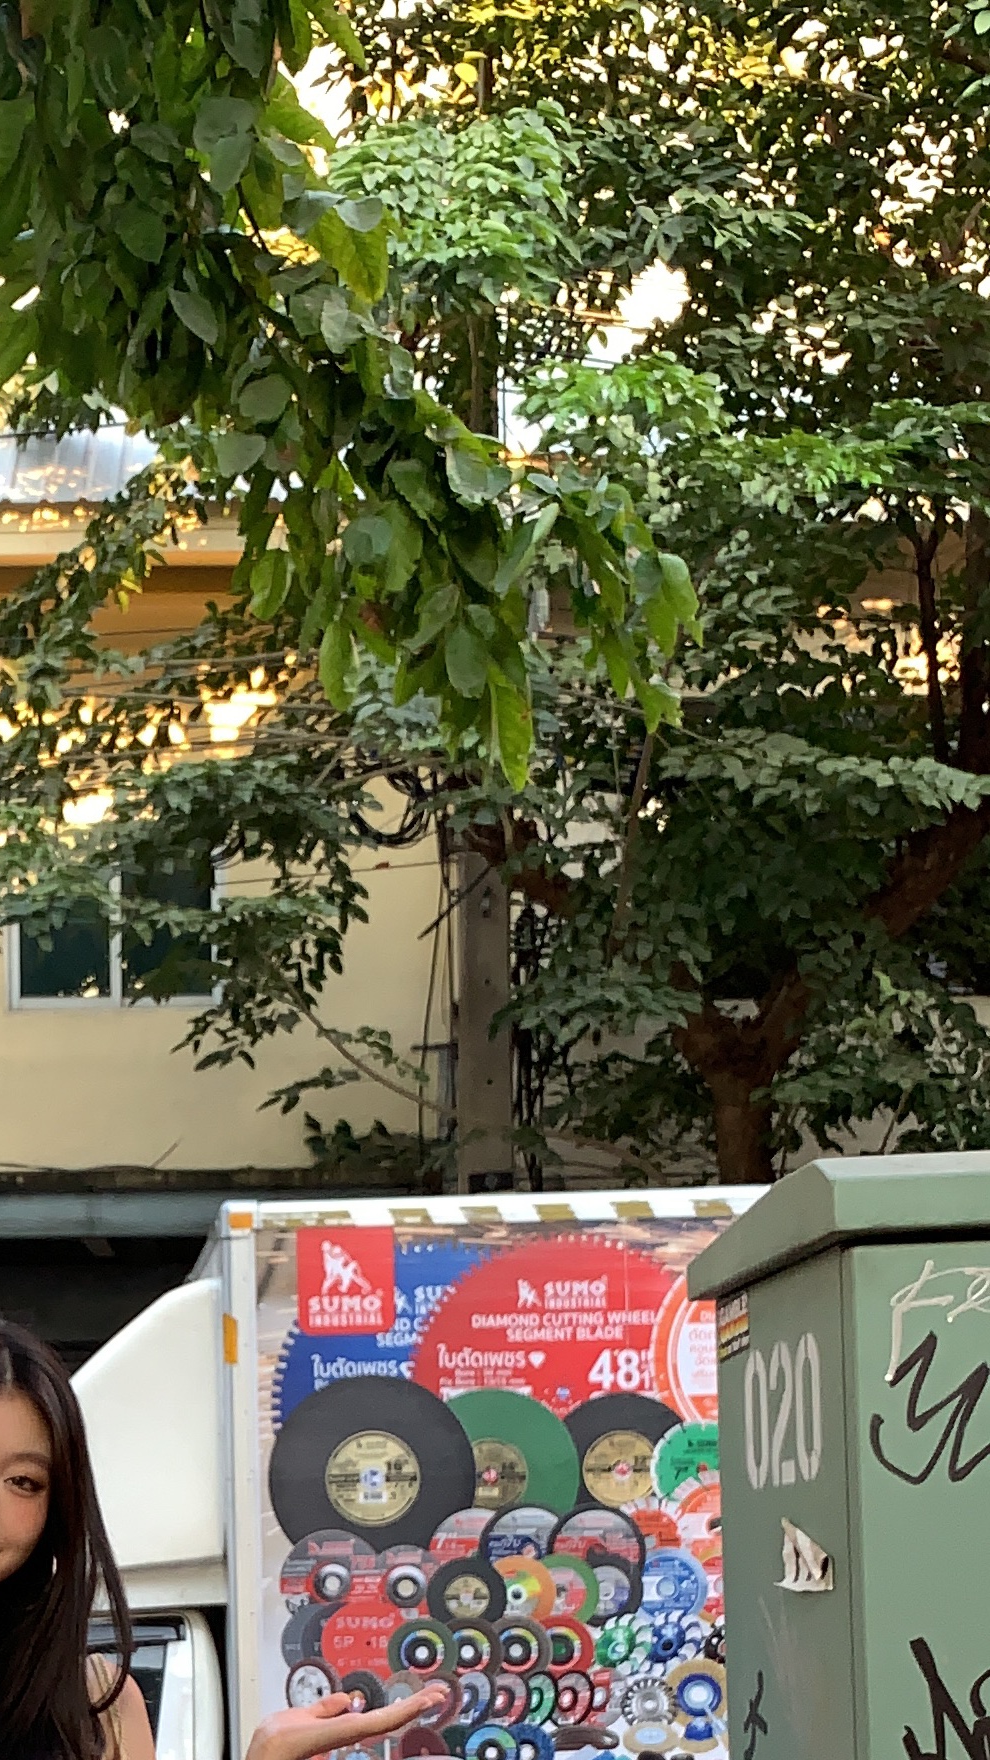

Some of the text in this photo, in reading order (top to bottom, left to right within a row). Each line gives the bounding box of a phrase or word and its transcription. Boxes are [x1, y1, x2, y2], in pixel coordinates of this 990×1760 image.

[544, 1278, 608, 1298] SUMO
[308, 1295, 383, 1313] SUMO
[308, 1312, 383, 1328] INDUSTRIAL
[470, 1311, 540, 1330] DIAMOND
[542, 1309, 604, 1328] CUTTING
[505, 1324, 624, 1344] SEGMENT BLADE
[744, 1332, 822, 1490] 020
[335, 1616, 394, 1630] SUMO
